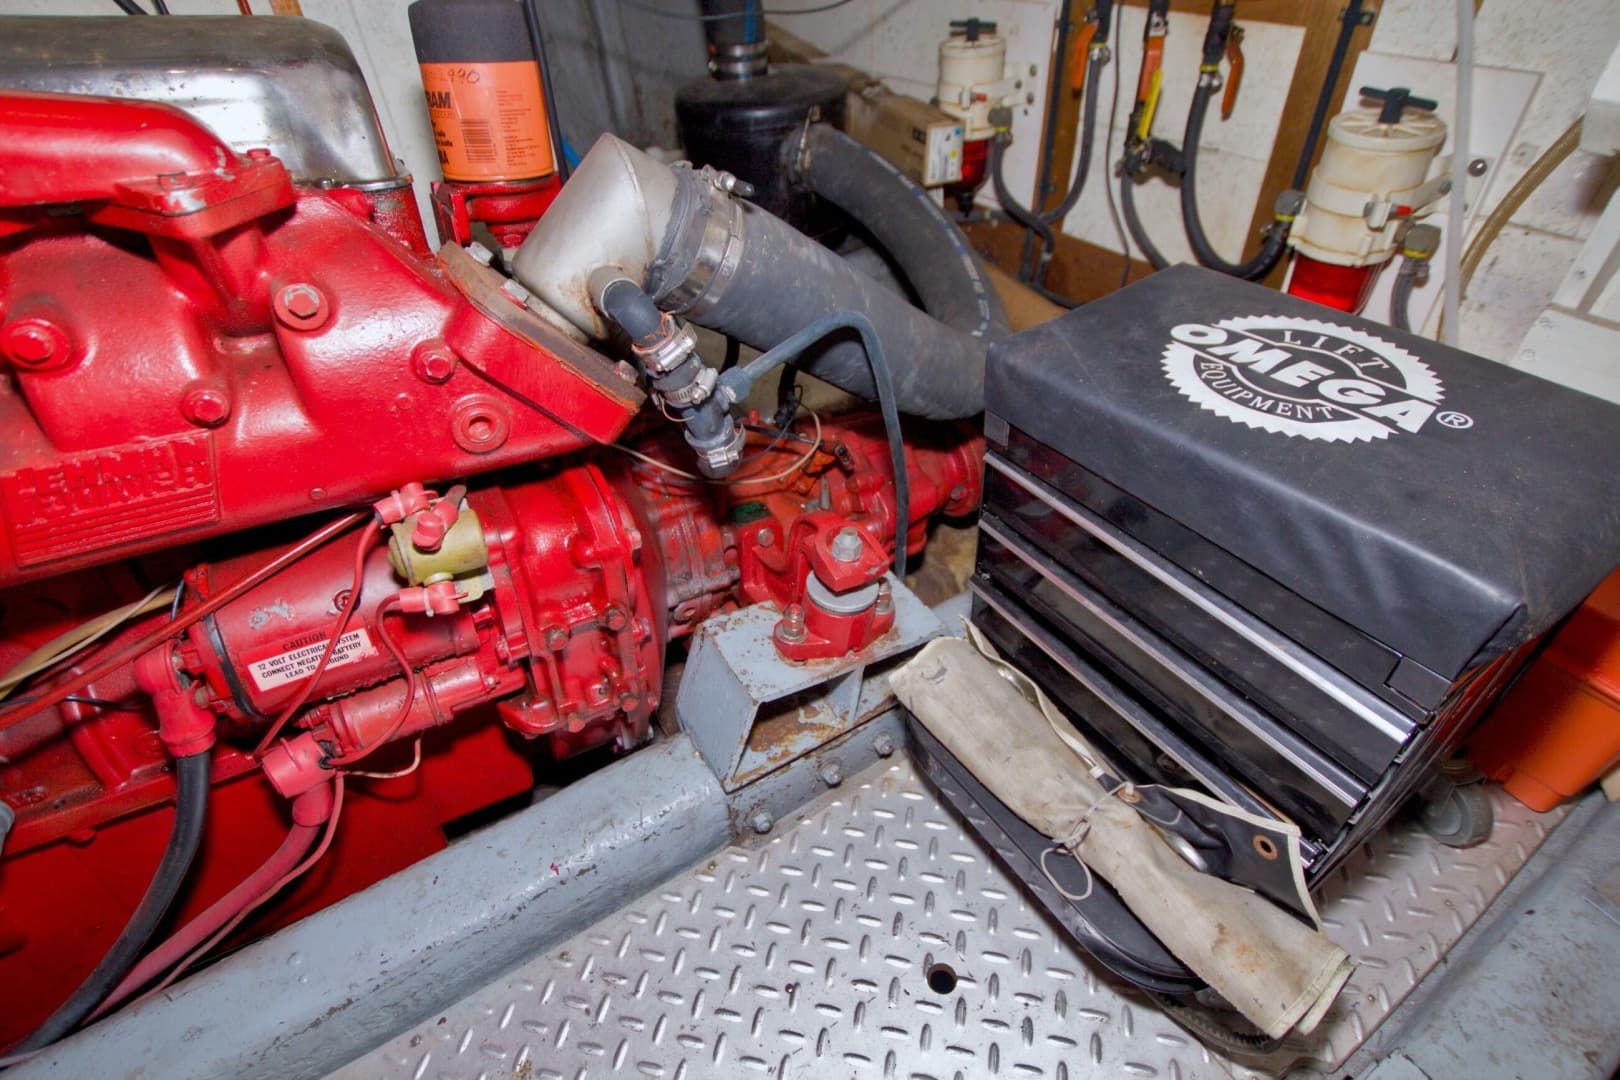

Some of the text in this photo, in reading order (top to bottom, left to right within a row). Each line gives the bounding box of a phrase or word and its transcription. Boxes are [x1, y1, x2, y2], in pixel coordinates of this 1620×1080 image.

[1283, 330, 1389, 371] LIFT
[1170, 323, 1438, 434] OMEGA
[1199, 360, 1334, 420] EQUIPMENT
[282, 631, 327, 651] CAUTION
[258, 663, 267, 671] 12
[269, 656, 286, 667] VOLT
[262, 663, 295, 678] CONNECT
[285, 668, 304, 679] LEAD
